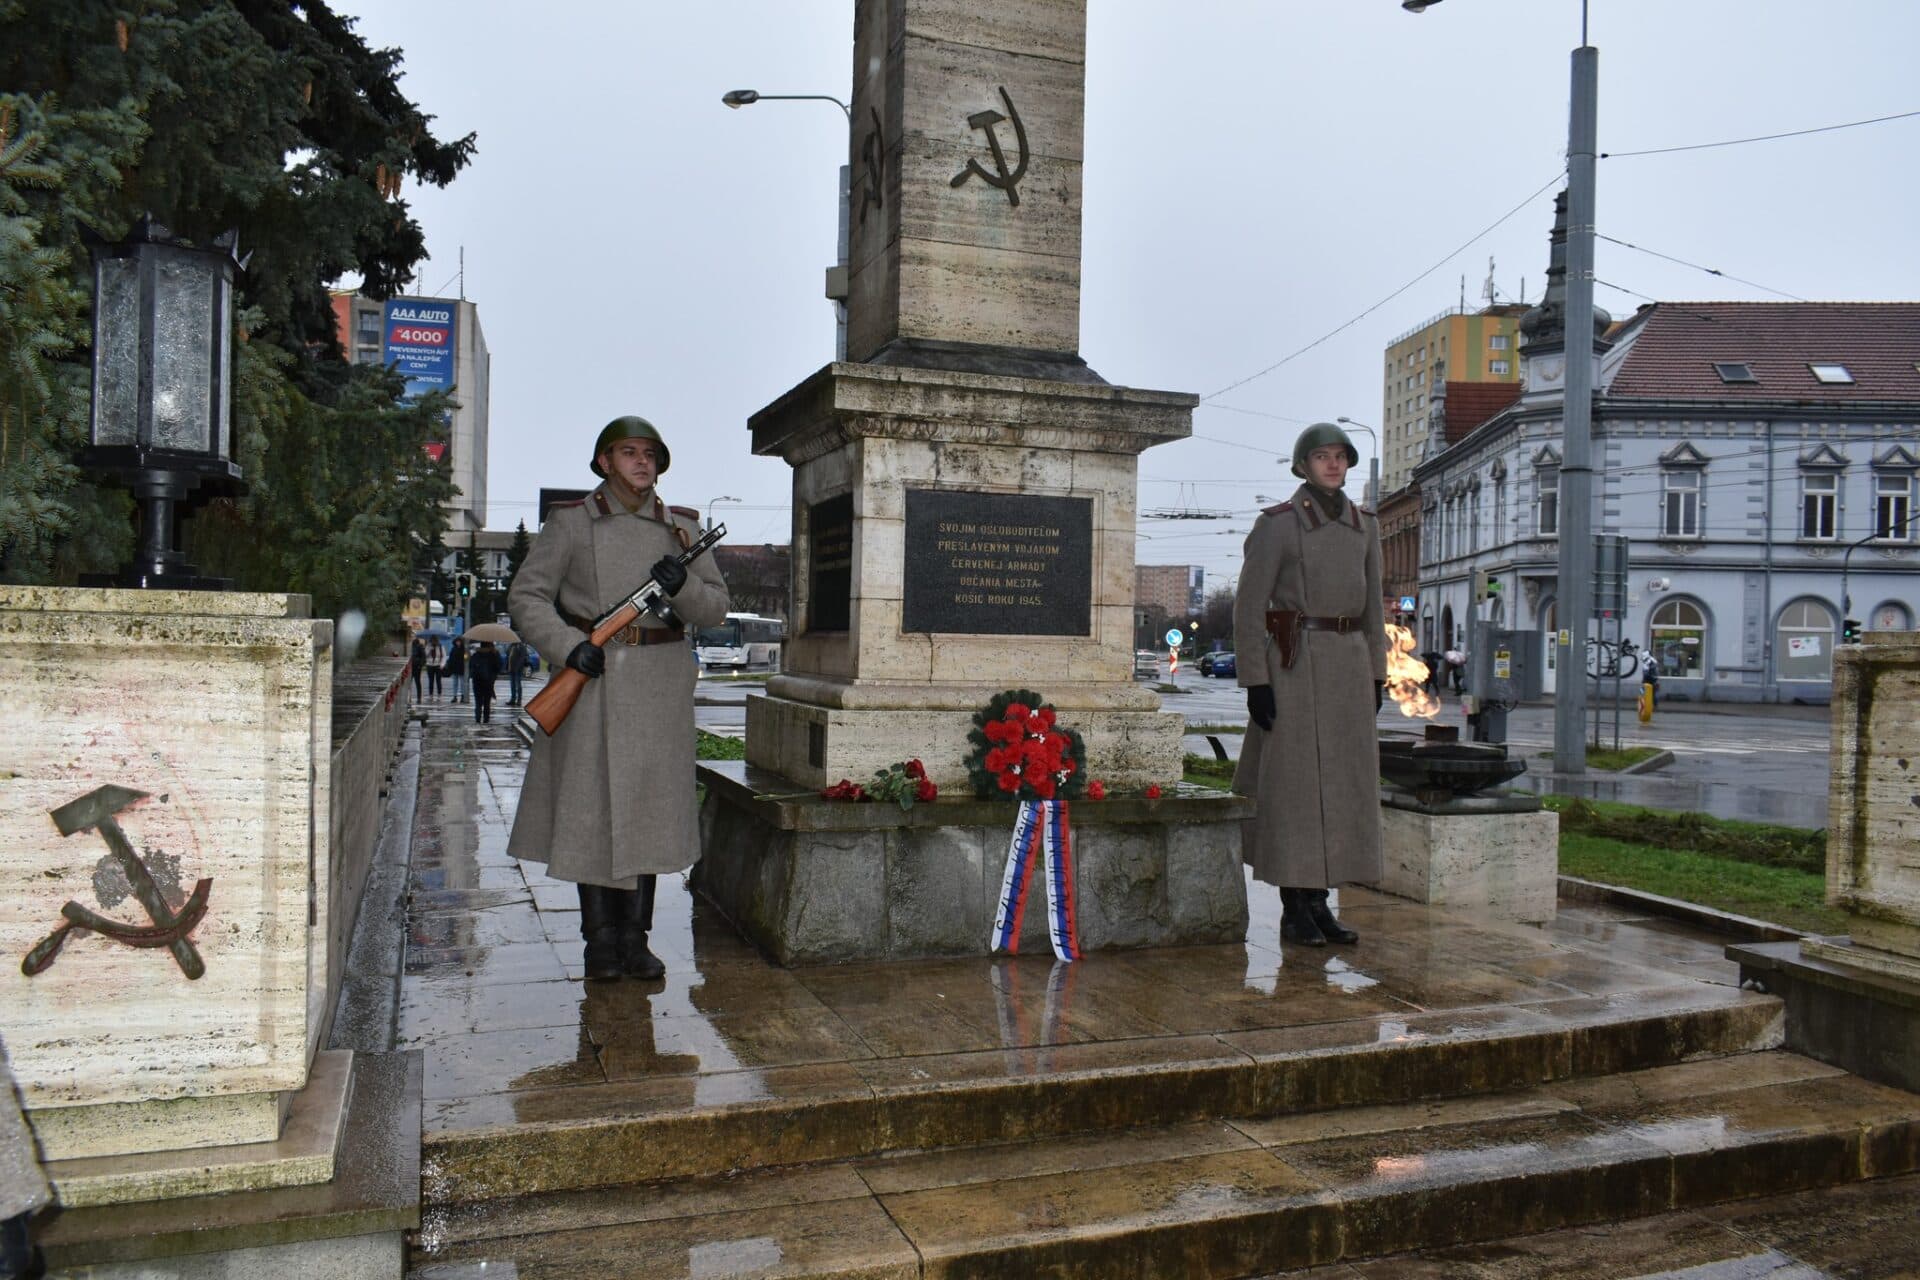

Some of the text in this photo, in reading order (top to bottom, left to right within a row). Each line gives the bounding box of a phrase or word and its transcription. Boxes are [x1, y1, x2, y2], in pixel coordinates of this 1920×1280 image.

[391, 307, 450, 321] AAA AUTO
[1015, 543, 1059, 555] VOJAKOM
[951, 556, 1003, 570] ČERVENEJ
[988, 594, 1015, 605] ROKU
